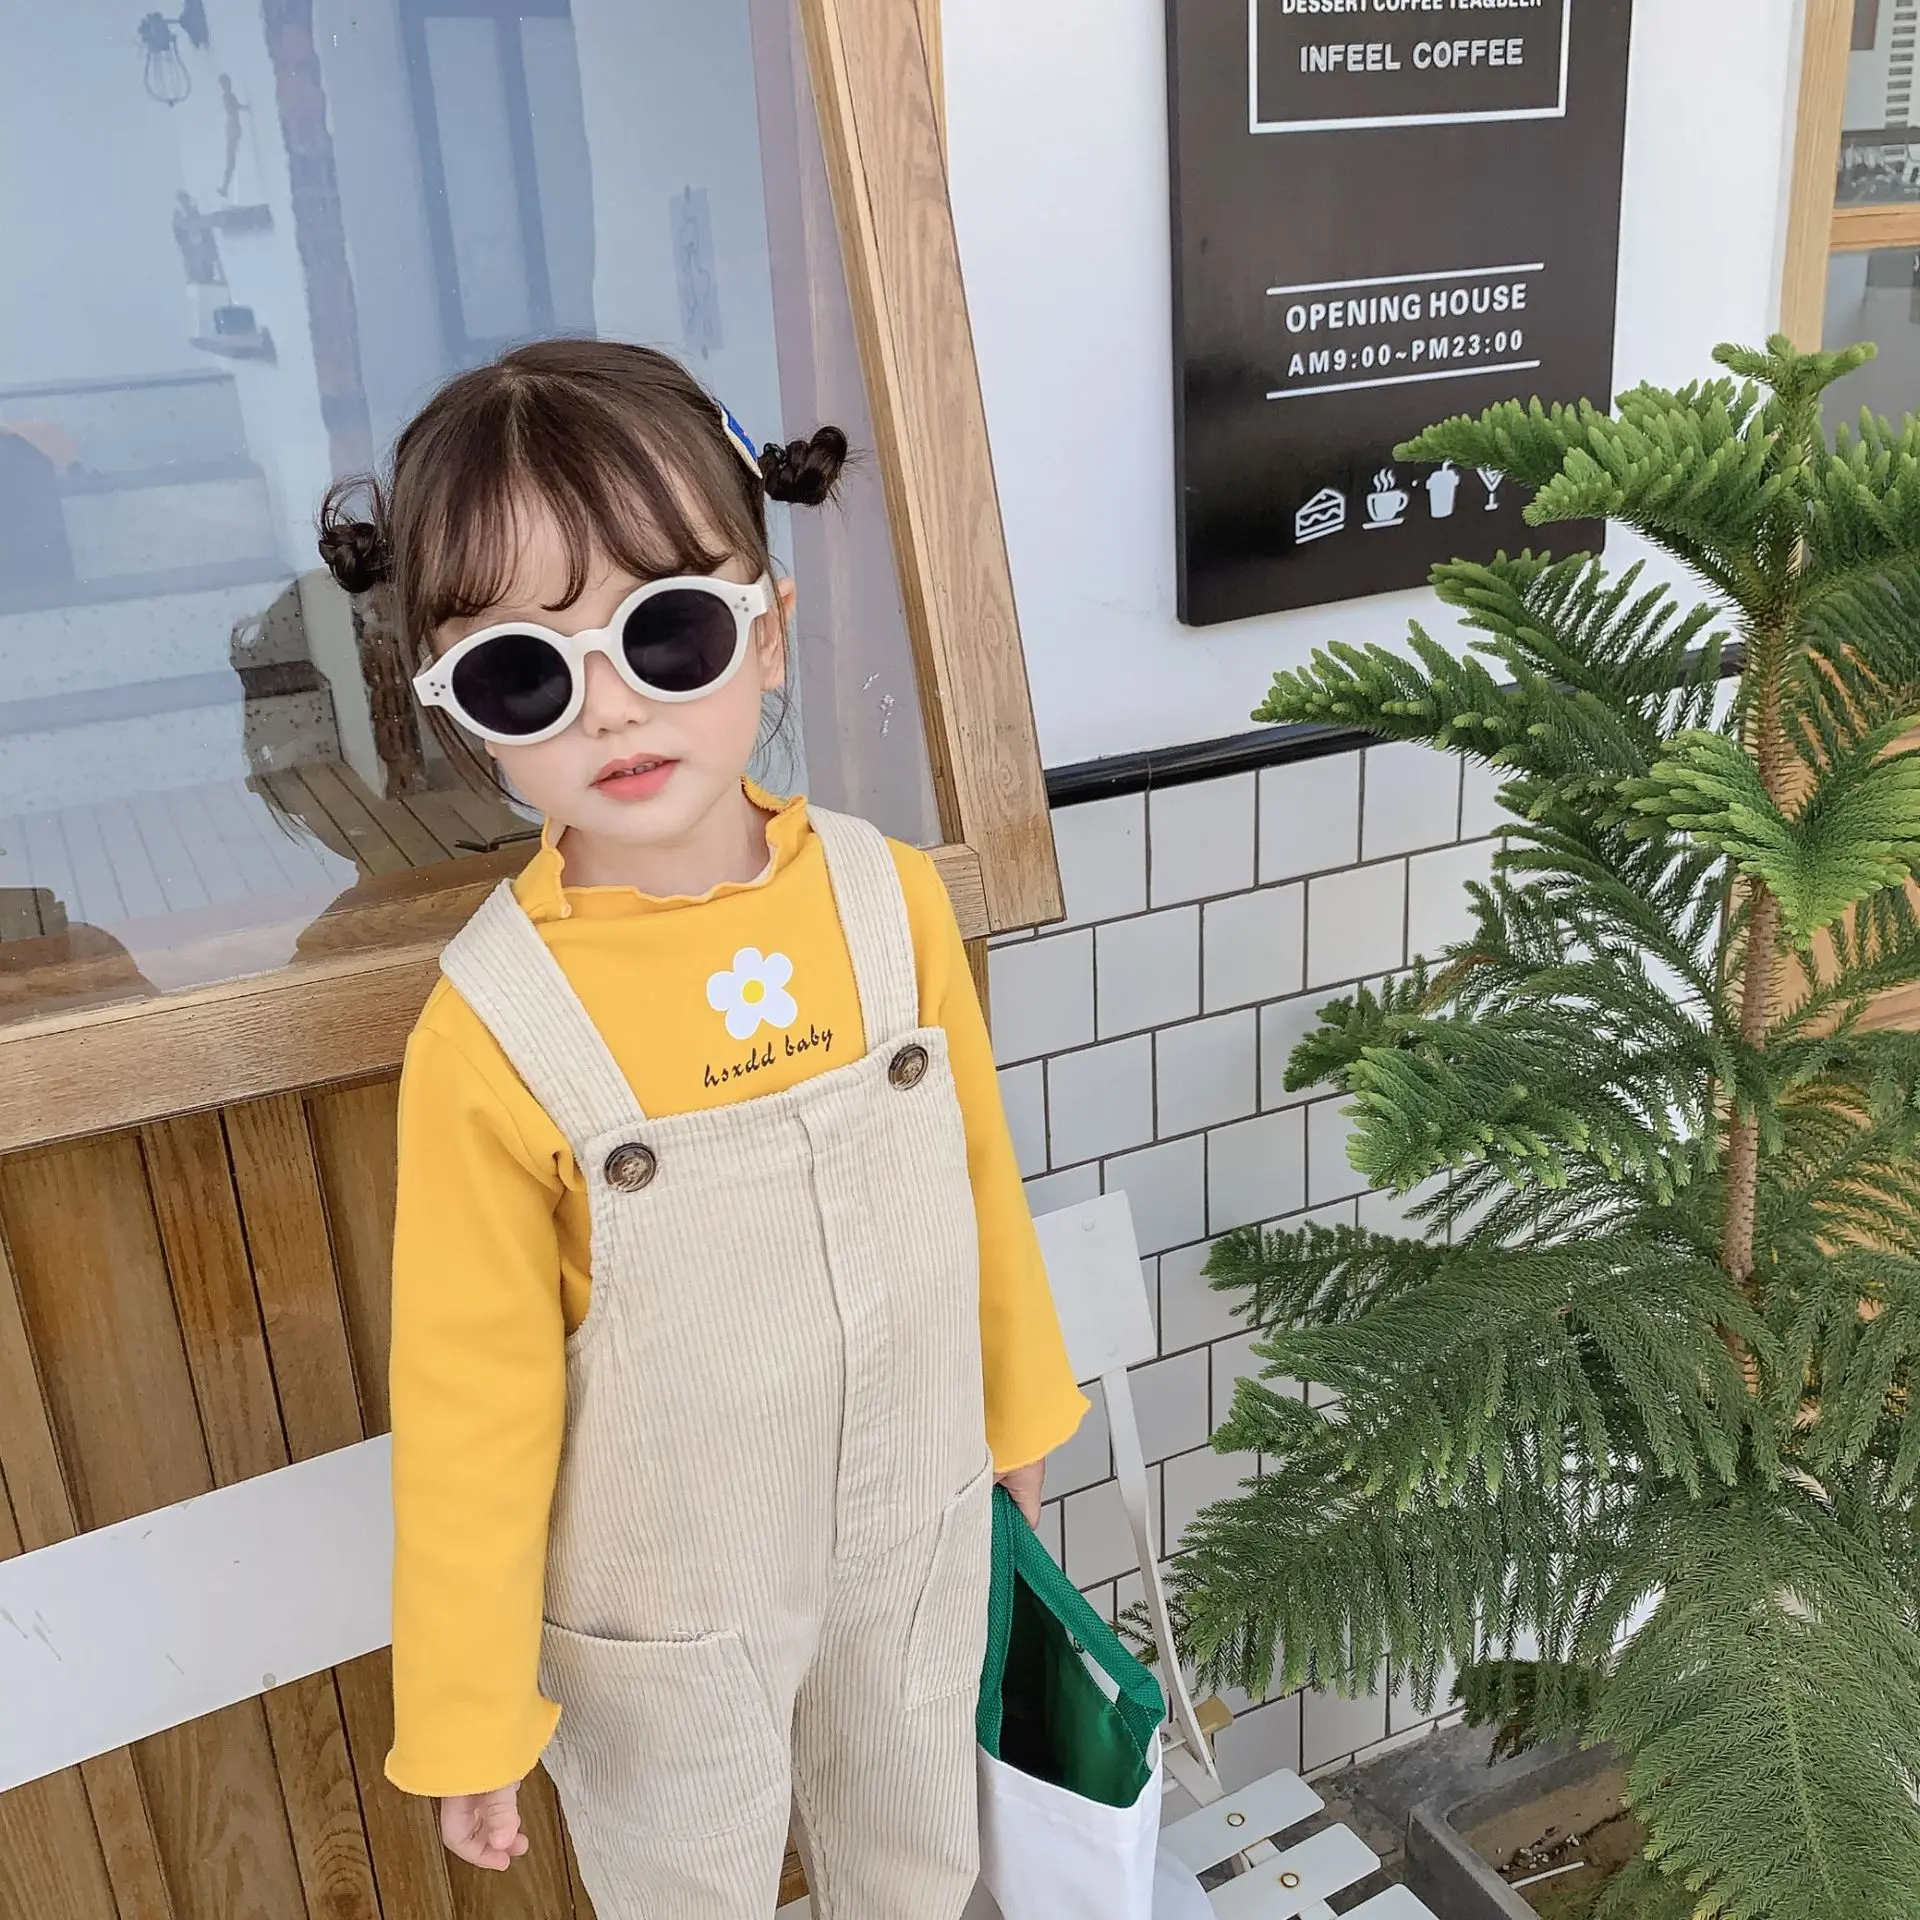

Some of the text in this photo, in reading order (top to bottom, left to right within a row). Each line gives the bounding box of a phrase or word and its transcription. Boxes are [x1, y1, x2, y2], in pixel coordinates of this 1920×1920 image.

[1282, 0, 1367, 14] DESSERT
[1372, 0, 1443, 12] COFFEE
[1300, 38, 1524, 73] INFEEL COFFEE
[1286, 283, 1527, 333] OPENING HOUSE
[1288, 329, 1523, 377] AM9:00~PM23:00
[704, 1024, 833, 1088] hsxdd baby
